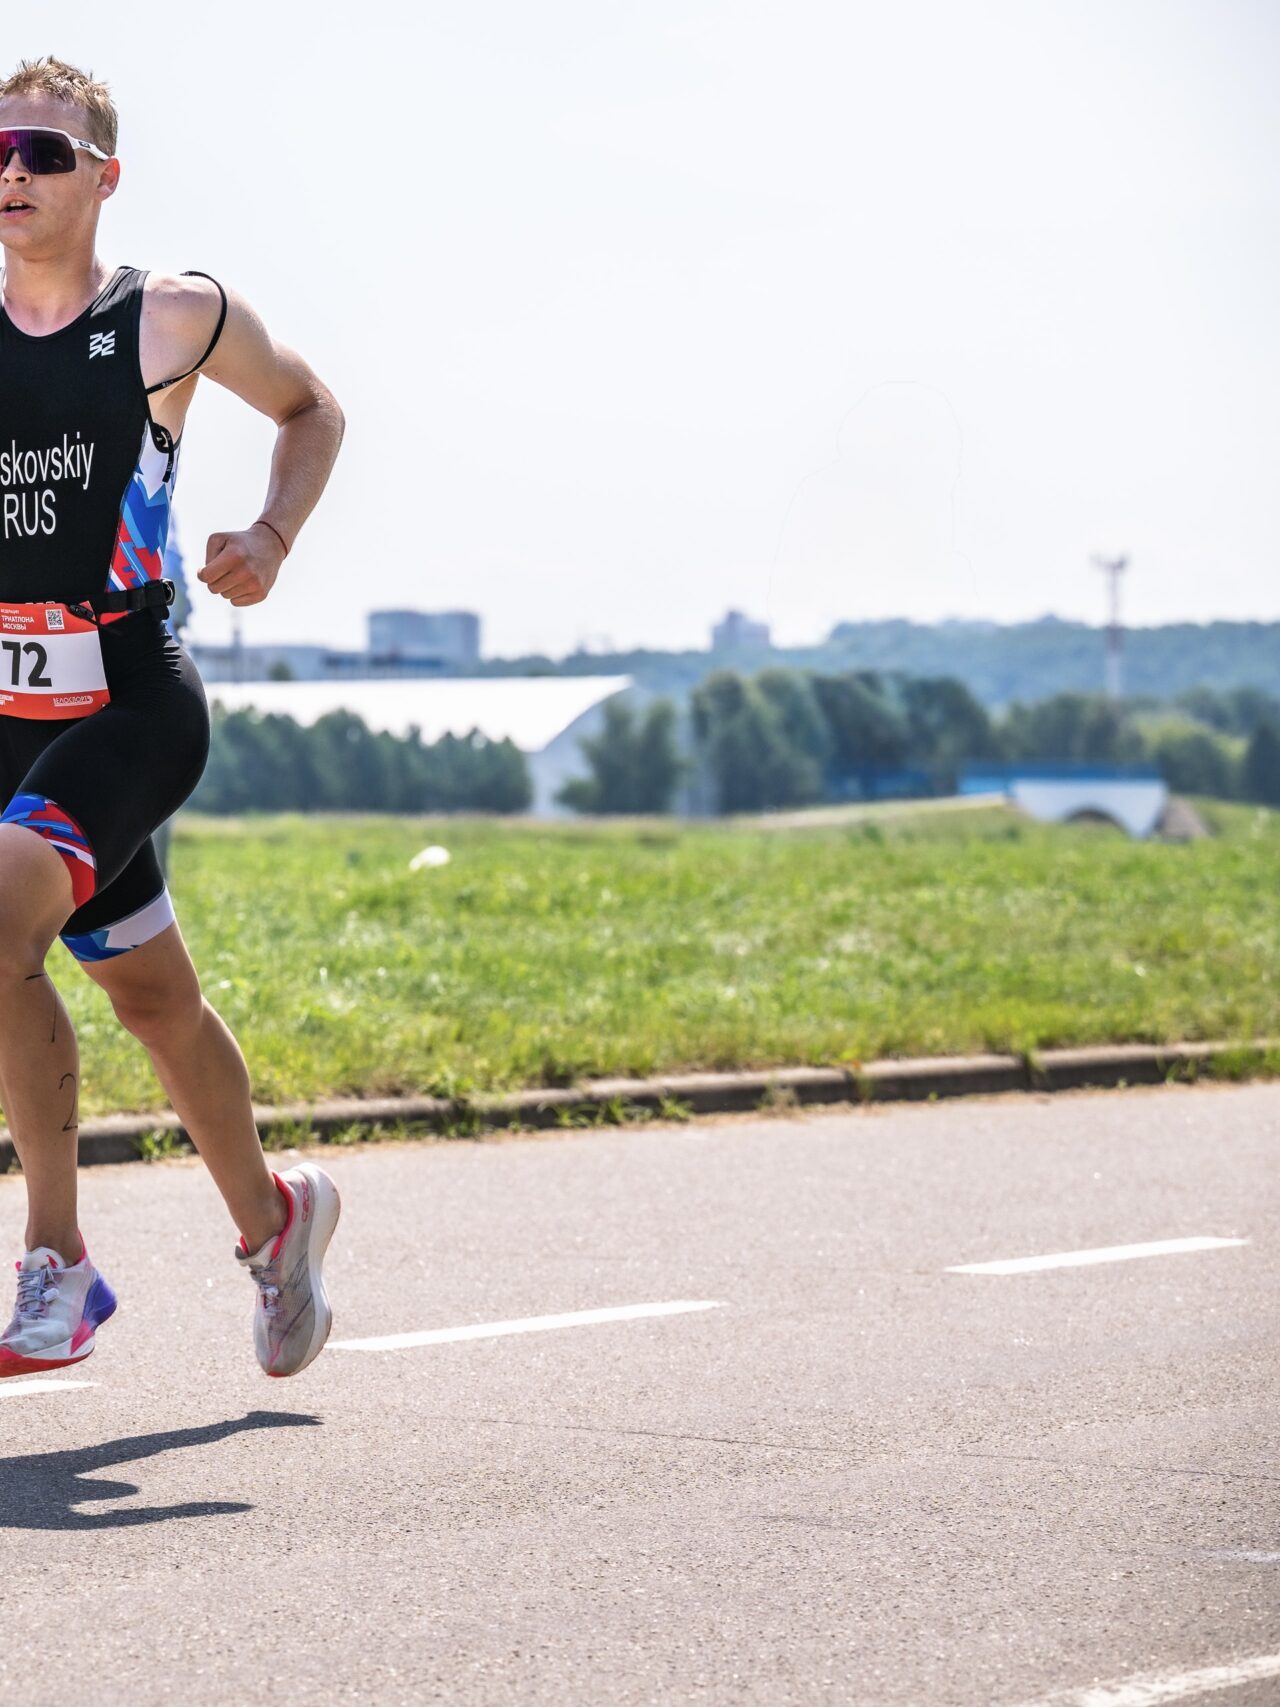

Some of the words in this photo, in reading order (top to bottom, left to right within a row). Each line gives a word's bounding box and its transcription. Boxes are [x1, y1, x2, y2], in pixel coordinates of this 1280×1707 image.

[3, 488, 56, 539] RUS
[1, 615, 34, 623] ТРИАТЛОНА
[2, 622, 27, 630] МОСКВЫ
[1, 641, 52, 687] 72
